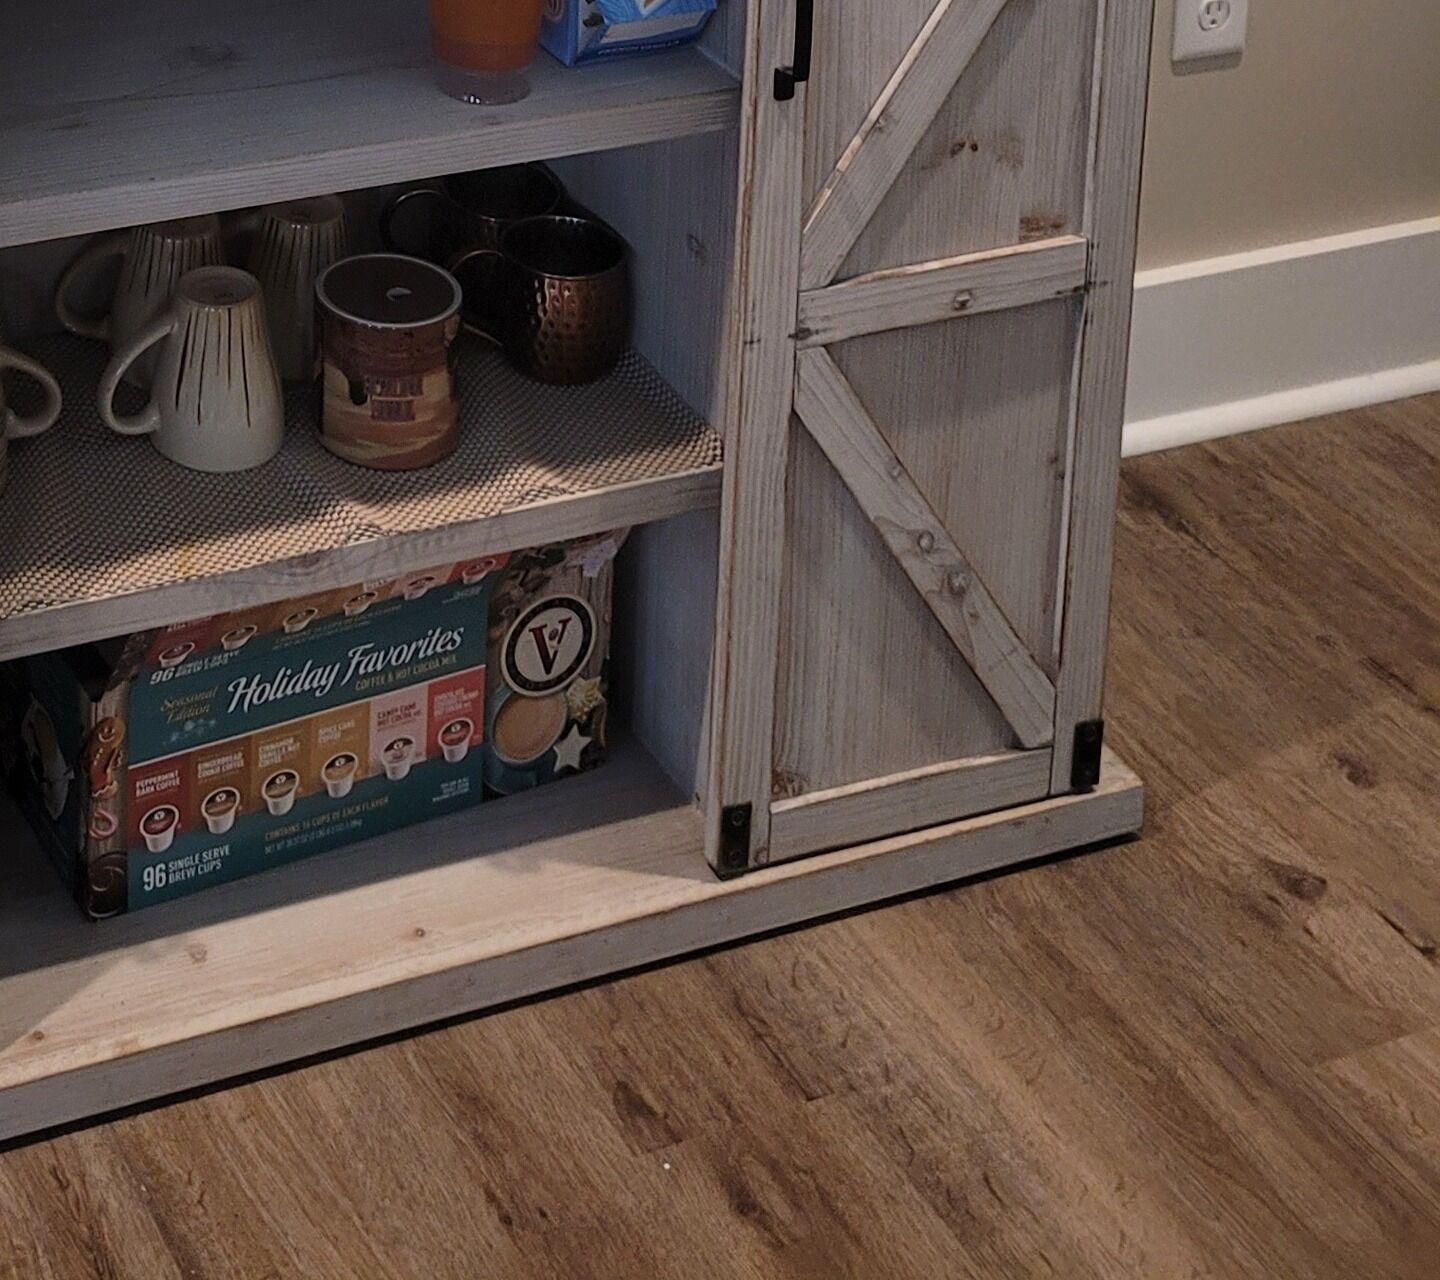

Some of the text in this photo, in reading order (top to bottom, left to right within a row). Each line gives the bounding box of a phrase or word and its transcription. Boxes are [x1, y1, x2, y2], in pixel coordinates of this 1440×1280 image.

[227, 659, 341, 713] Holiday
[339, 627, 465, 687] Favorites
[143, 844, 231, 891] 96 SINGLE SERVE
[168, 859, 222, 884] BREW CUPS
